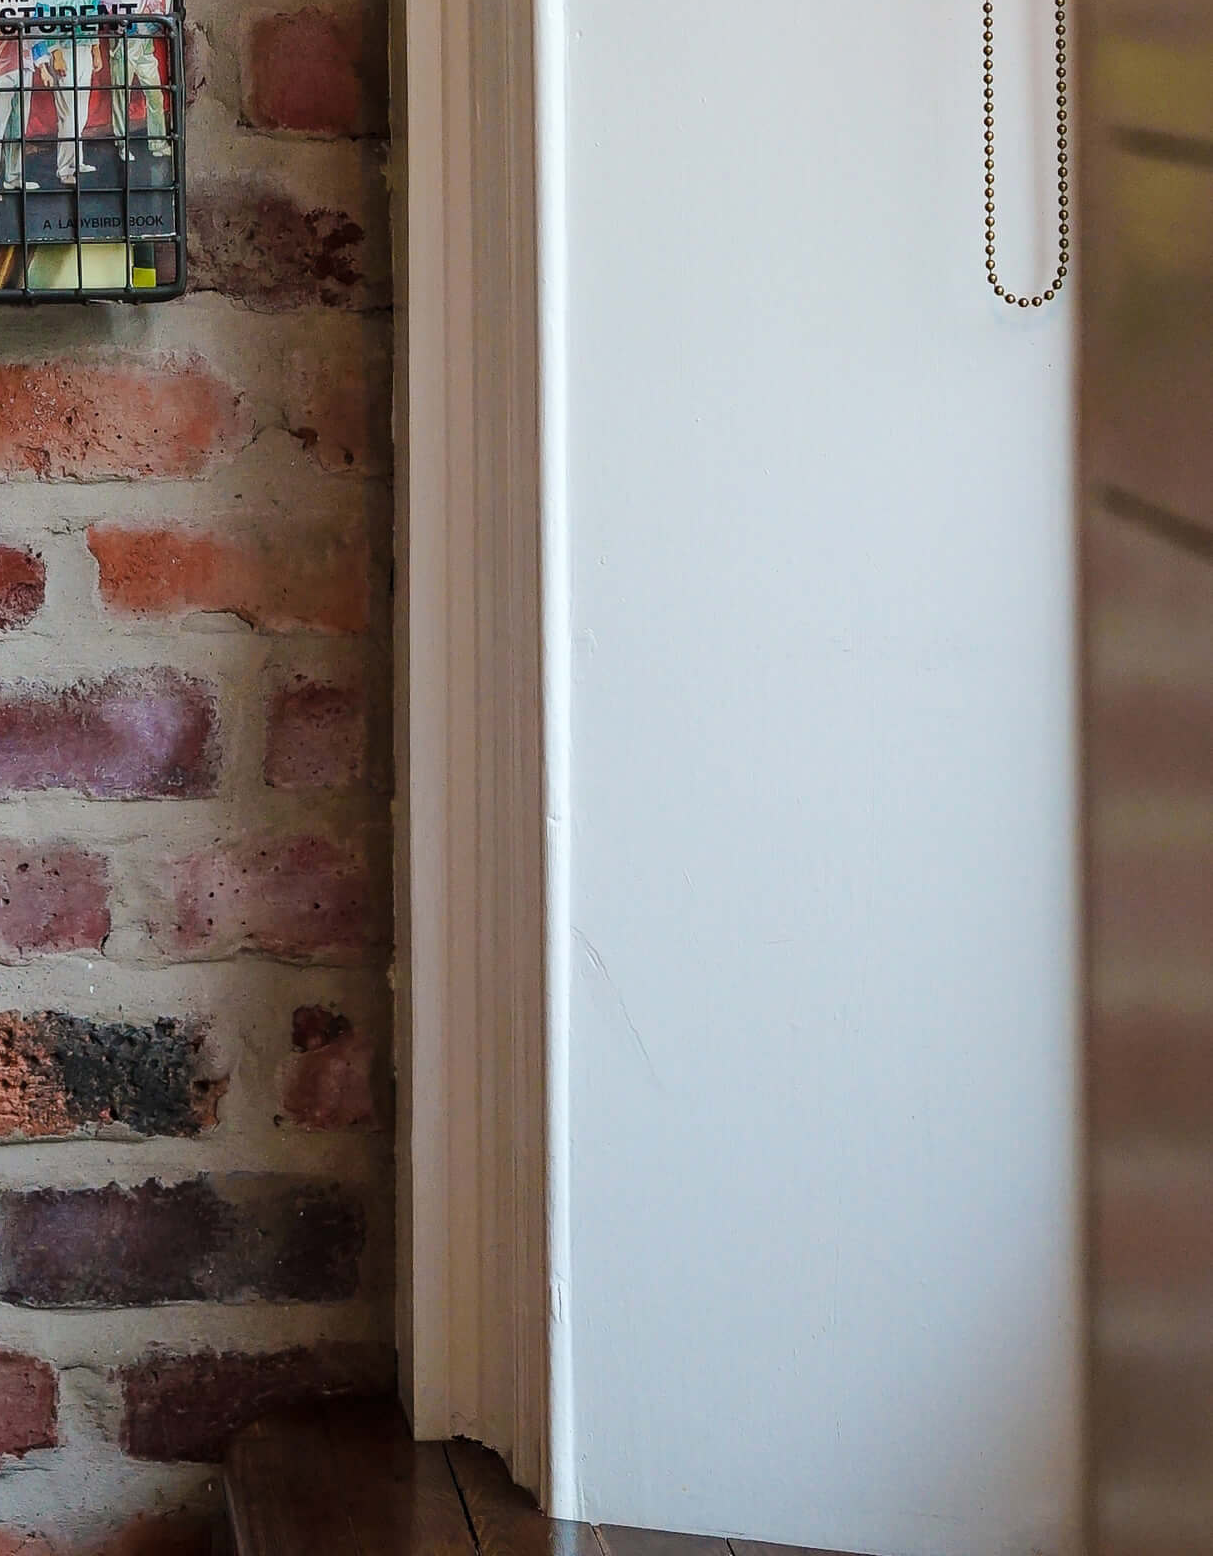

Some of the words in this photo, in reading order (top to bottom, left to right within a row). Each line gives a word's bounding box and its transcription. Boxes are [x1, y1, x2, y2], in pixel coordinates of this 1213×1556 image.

[0, 3, 138, 34] STUDENT
[42, 219, 52, 230] A
[129, 215, 164, 227] BOOK
